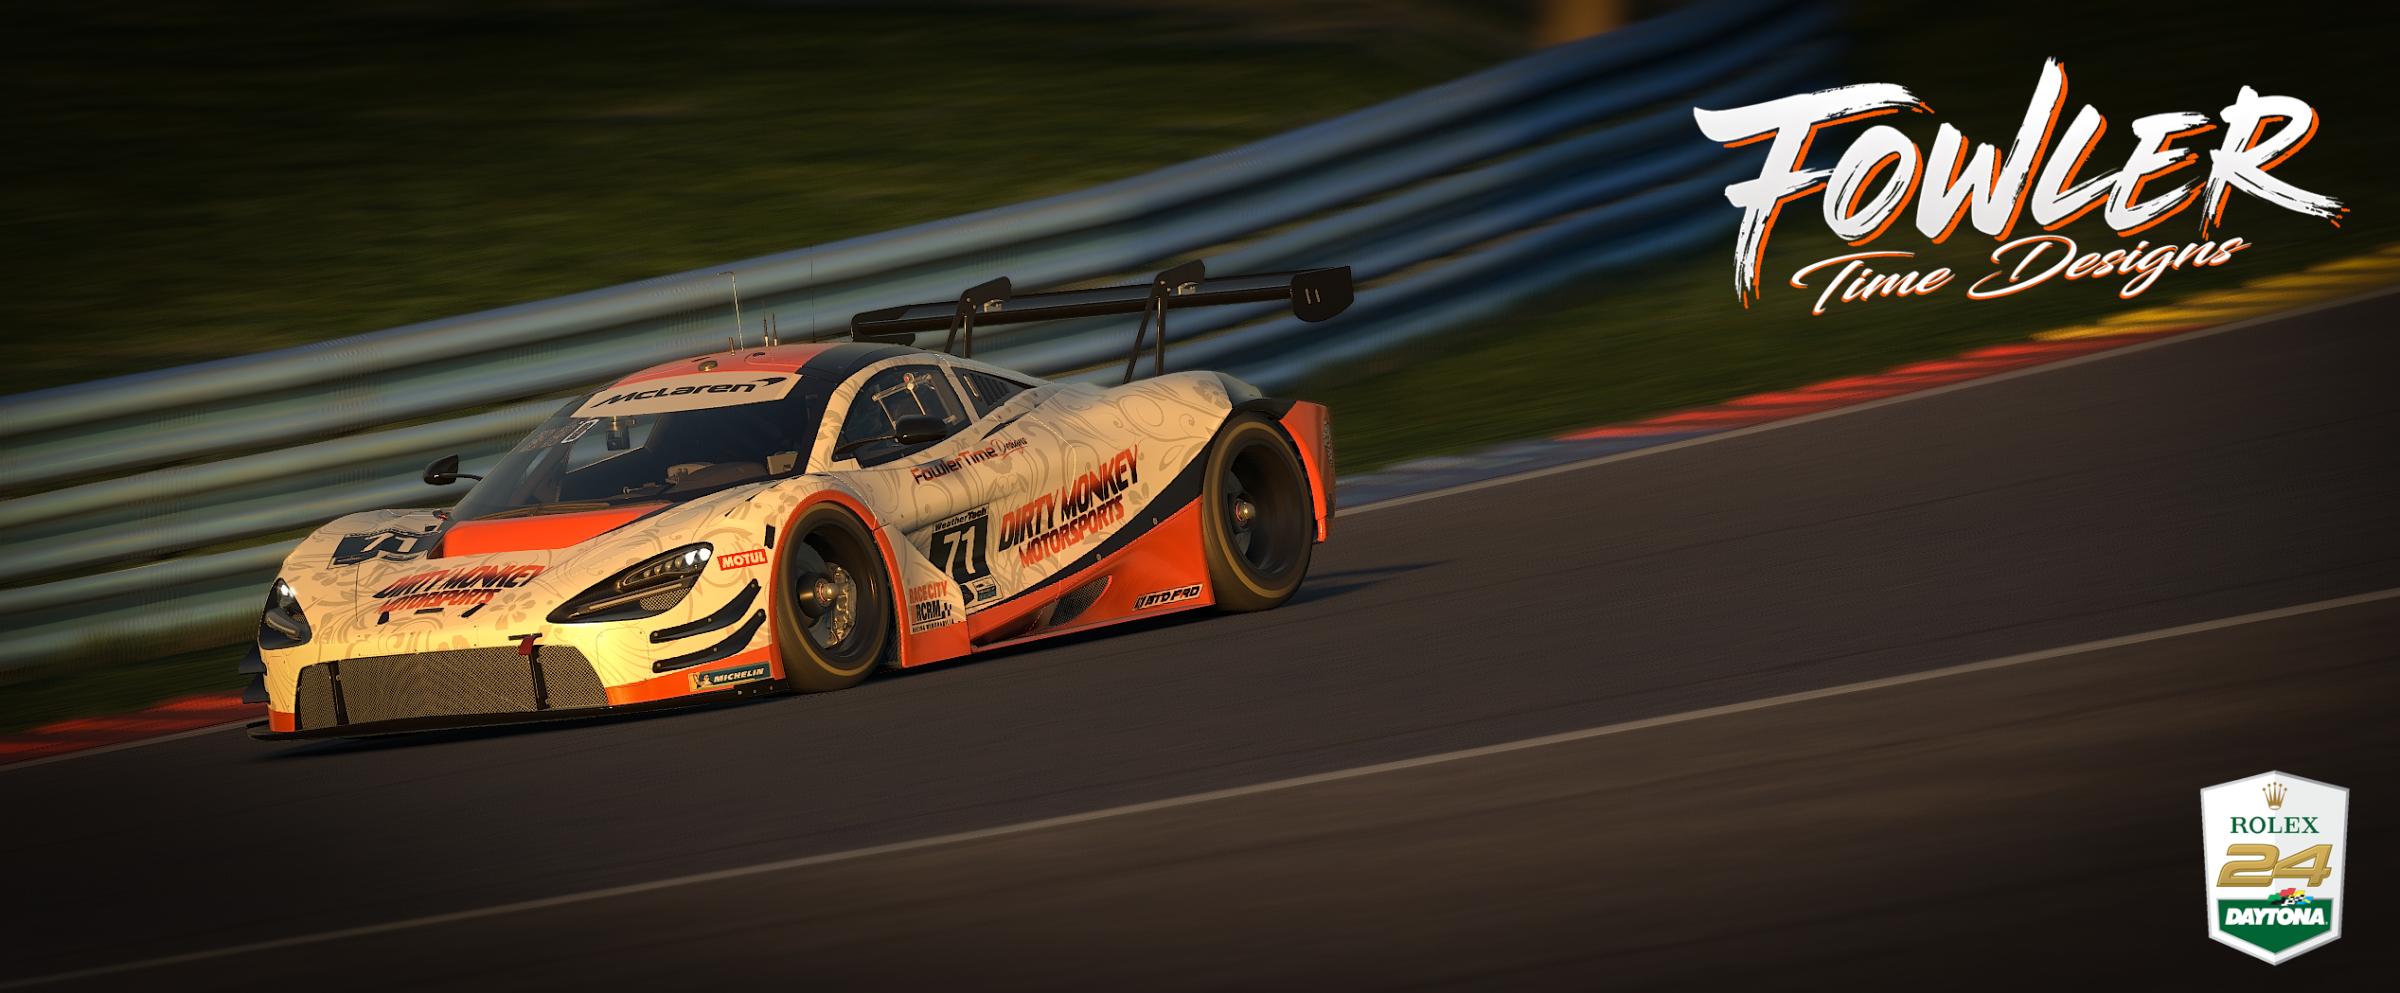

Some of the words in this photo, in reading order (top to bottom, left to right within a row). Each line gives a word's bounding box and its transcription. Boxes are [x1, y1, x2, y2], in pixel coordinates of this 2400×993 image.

[590, 383, 757, 408] McLaren
[999, 490, 1058, 552] DIRTY
[1061, 443, 1138, 522] MONKEY
[935, 507, 987, 531] WeatherTech
[1018, 494, 1125, 568] MOTORSPORTS
[722, 551, 766, 569] MOTUL
[943, 526, 976, 580] 71
[372, 569, 449, 598] DIRTY
[438, 565, 546, 588] MONKEY
[928, 581, 947, 600] CITY
[374, 589, 502, 614] MOTORSPORTS
[714, 668, 765, 682] MICHELIN
